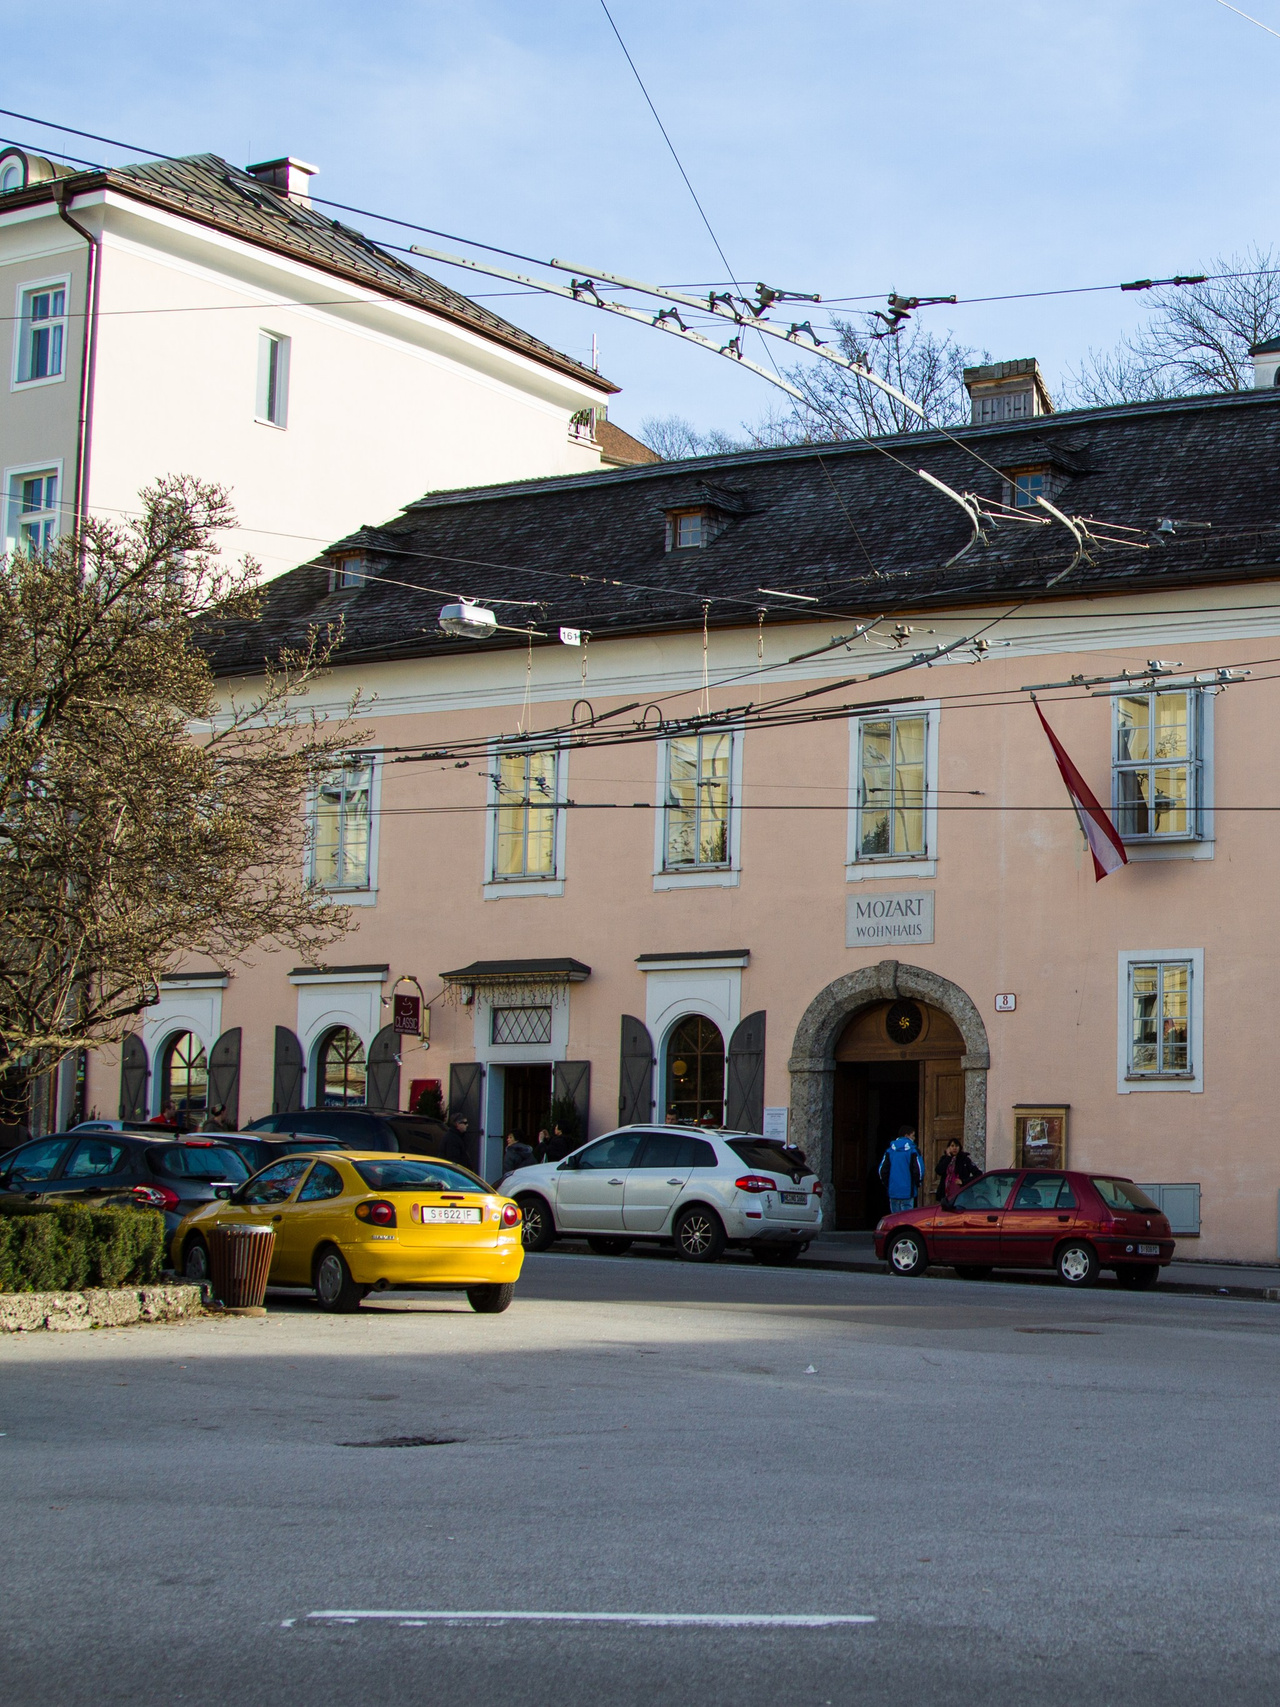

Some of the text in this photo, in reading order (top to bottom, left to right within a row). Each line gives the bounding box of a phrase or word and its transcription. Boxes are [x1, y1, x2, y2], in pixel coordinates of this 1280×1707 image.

[562, 631, 577, 641] 161
[856, 899, 924, 919] MOZART
[856, 924, 922, 938] WOHNHAUS
[1002, 995, 1008, 1005] 8
[396, 1016, 418, 1029] CLASSIC
[430, 1209, 437, 1218] S
[444, 1209, 461, 1219] 622
